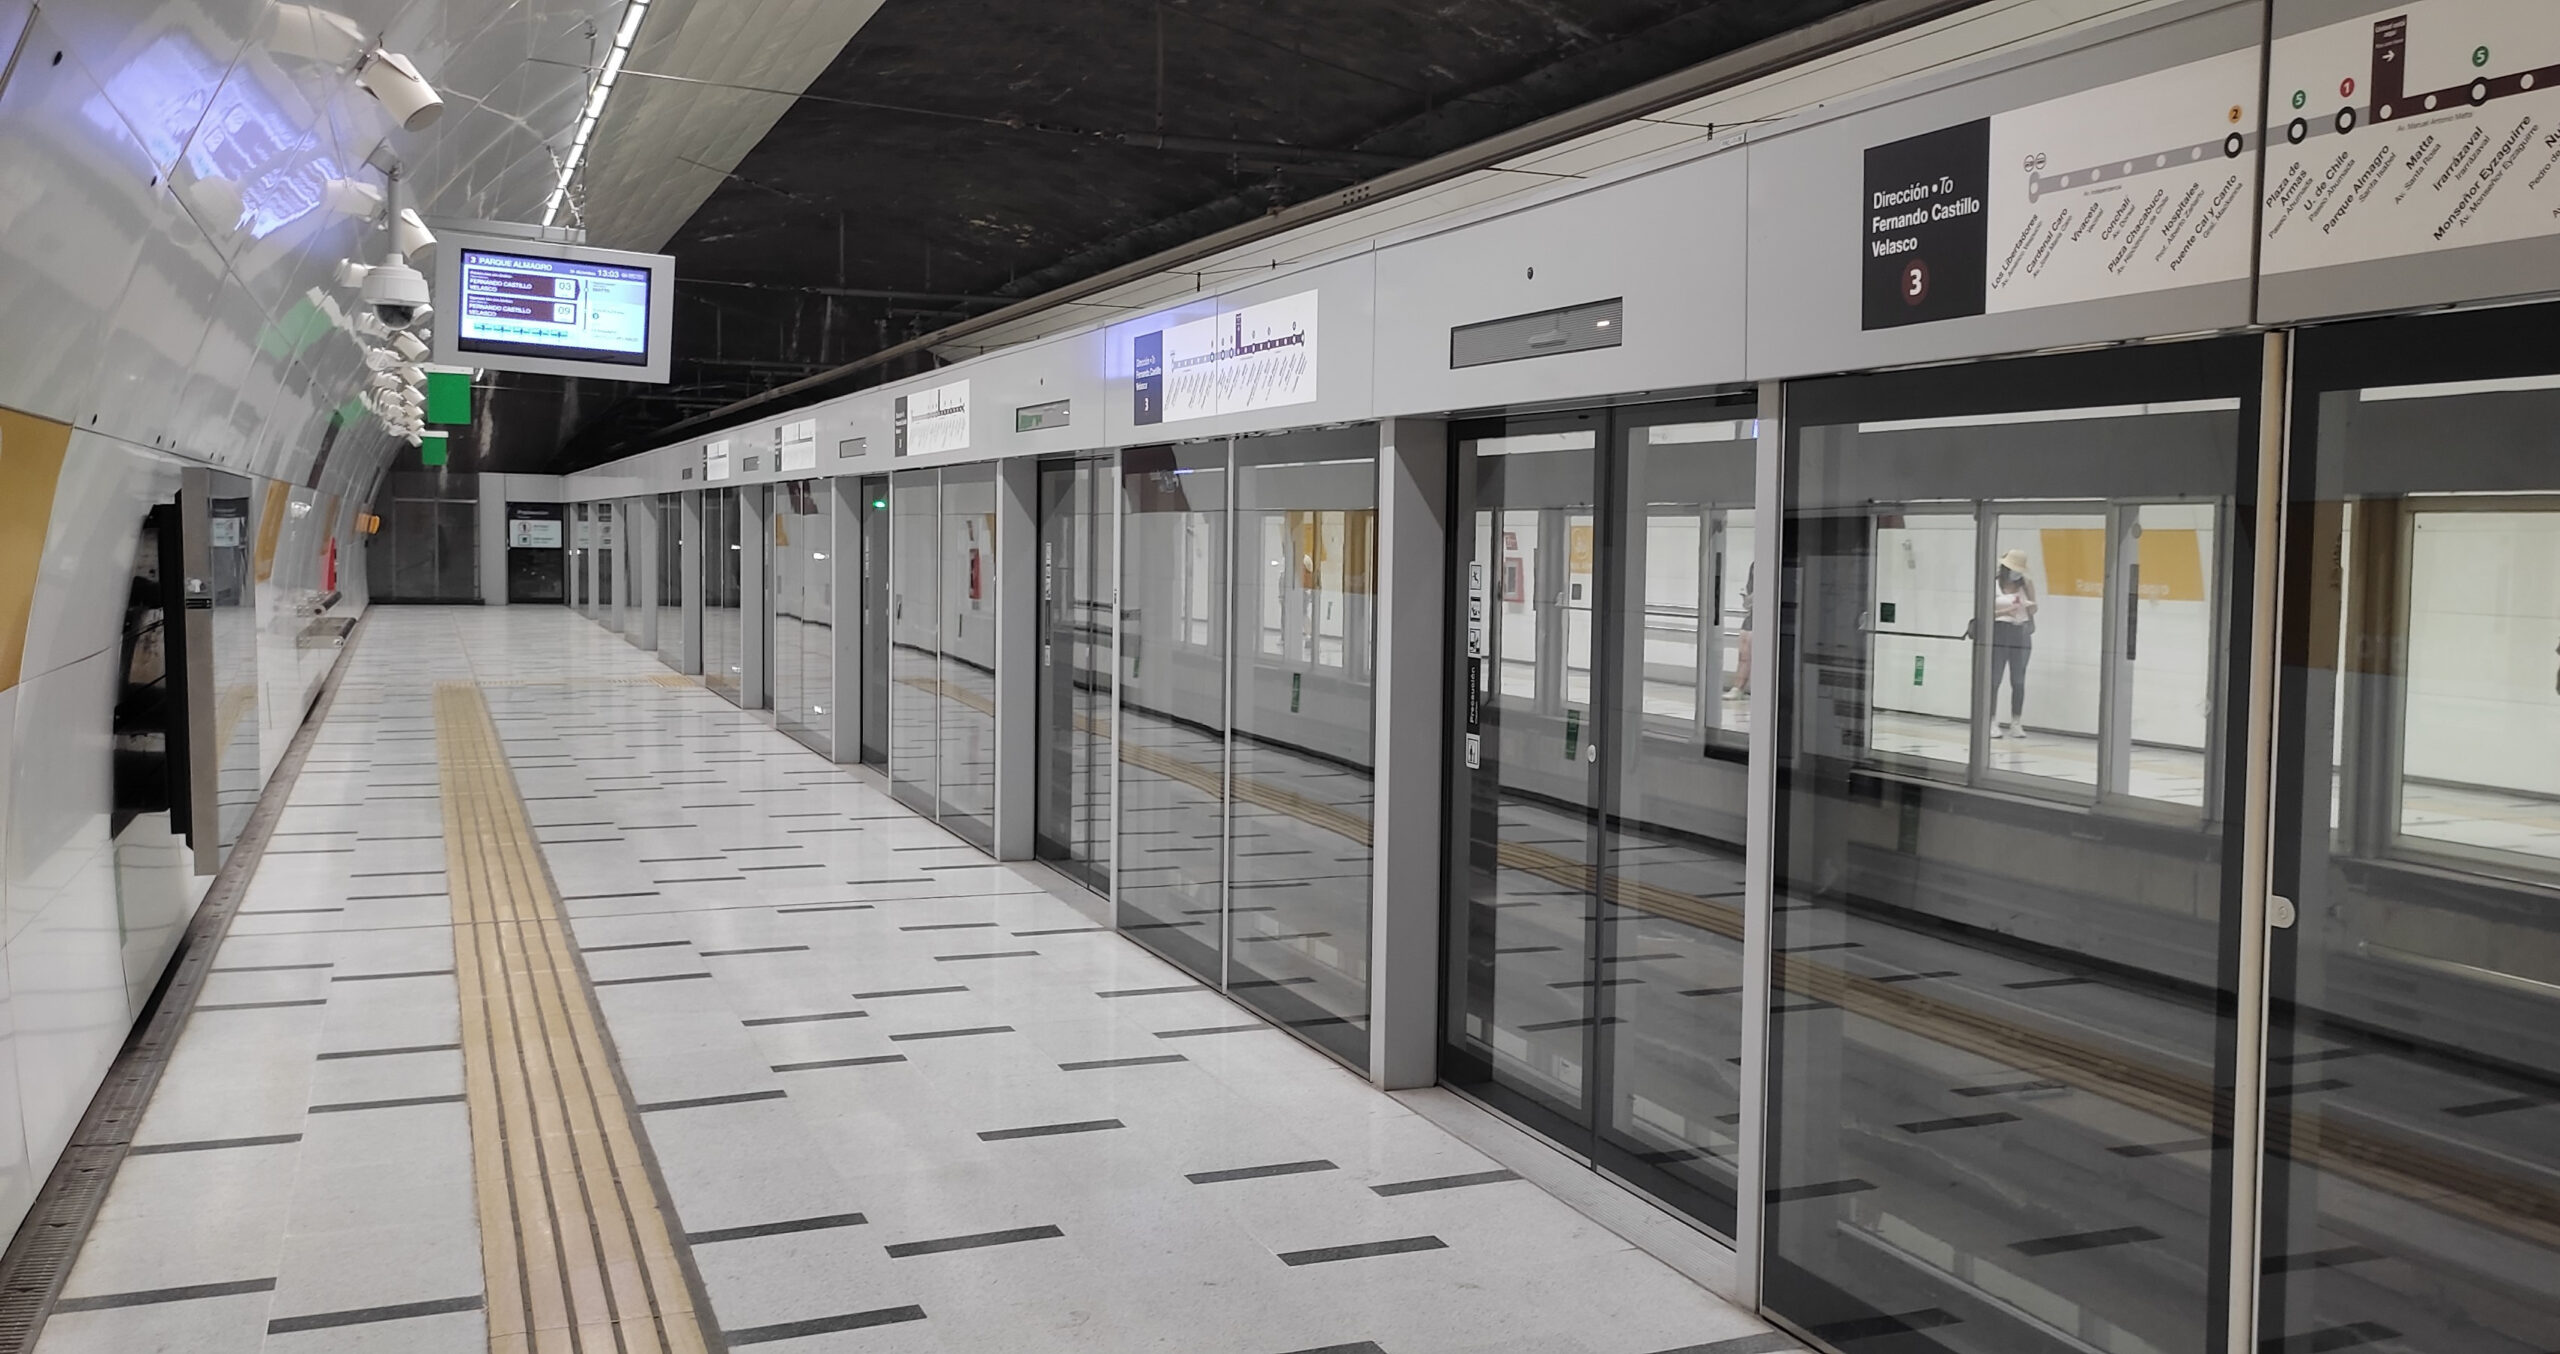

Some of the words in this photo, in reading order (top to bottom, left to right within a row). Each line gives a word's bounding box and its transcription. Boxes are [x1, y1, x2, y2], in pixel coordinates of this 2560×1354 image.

[2476, 51, 2485, 62] 5
[2295, 94, 2303, 105] 5
[2343, 82, 2350, 93] 1
[2232, 108, 2239, 119] 2
[2405, 135, 2434, 170] Matta
[2544, 122, 2560, 149] Ñu
[2315, 181, 2327, 197] de
[2325, 151, 2349, 180] Chile
[2432, 125, 2483, 192] Irarrázaval
[1873, 182, 1929, 210] Dirección
[1939, 176, 1954, 195] To
[2265, 178, 2289, 208] Plaza
[2288, 161, 2300, 177] de
[2280, 170, 2307, 207] Armas
[2322, 194, 2353, 235] Parque
[2352, 145, 2389, 194] Almagro
[2359, 178, 2379, 203] Santa
[2404, 166, 2425, 191] Santa
[2433, 180, 2481, 241] Monseñor
[2478, 115, 2531, 181] Eyzaguirre
[2528, 163, 2551, 191] Pedro
[1872, 208, 1929, 233] Fernando
[1931, 196, 1980, 221] Castillo
[2071, 202, 2099, 242] Vivaceta
[2161, 182, 2200, 237] Hospitales
[2170, 235, 2196, 272] Puente
[2194, 213, 2209, 234] Cal
[2207, 206, 2215, 218] y
[2213, 174, 2237, 207] Canto
[1872, 237, 1918, 258] Velasco
[2026, 230, 2054, 274] Cardenal
[2051, 208, 2068, 232] Caro
[2107, 245, 2128, 273] Plaza
[2125, 188, 2164, 245] Chacabuco
[470, 255, 477, 264] 3
[479, 256, 512, 267] PARQUE
[513, 260, 553, 271] ALMAGRO
[1991, 271, 2004, 290] Los
[2002, 213, 2038, 271] Libertadores
[469, 278, 503, 287] FERNANDO
[503, 281, 533, 290] CASTILLO
[1909, 268, 1923, 296] 3
[502, 305, 532, 315] CASTILLO
